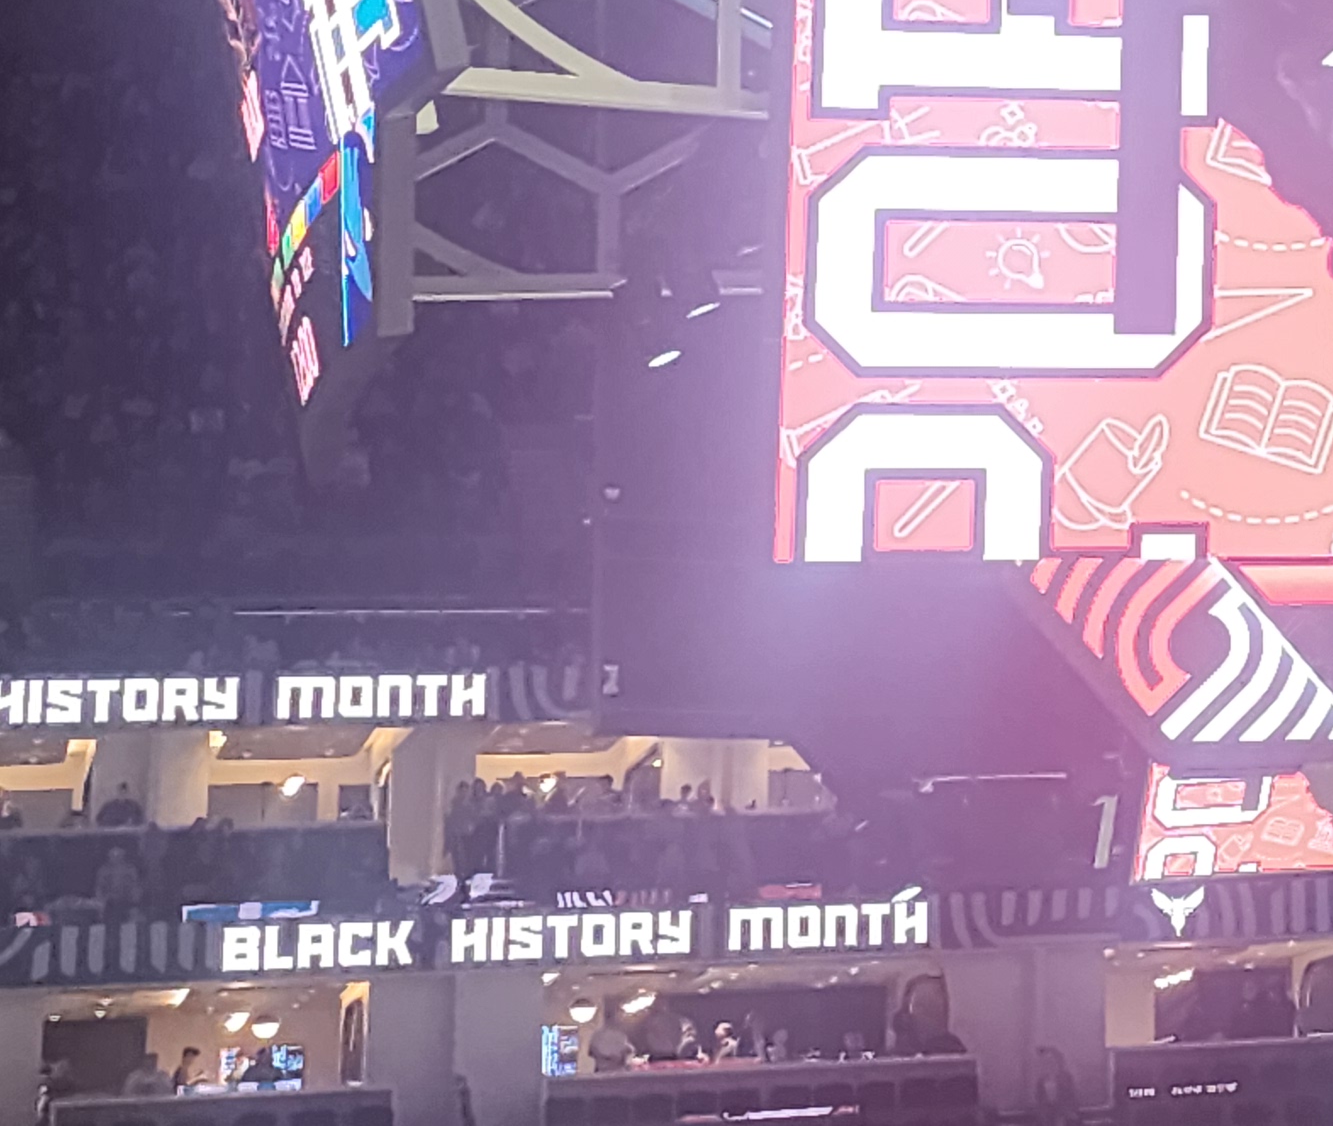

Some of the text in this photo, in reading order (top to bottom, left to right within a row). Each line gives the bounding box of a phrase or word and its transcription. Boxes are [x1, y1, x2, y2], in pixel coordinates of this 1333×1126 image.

[0, 673, 487, 725] HISTORY MONTH
[222, 902, 928, 972] BLACK HISTORY MONTH
